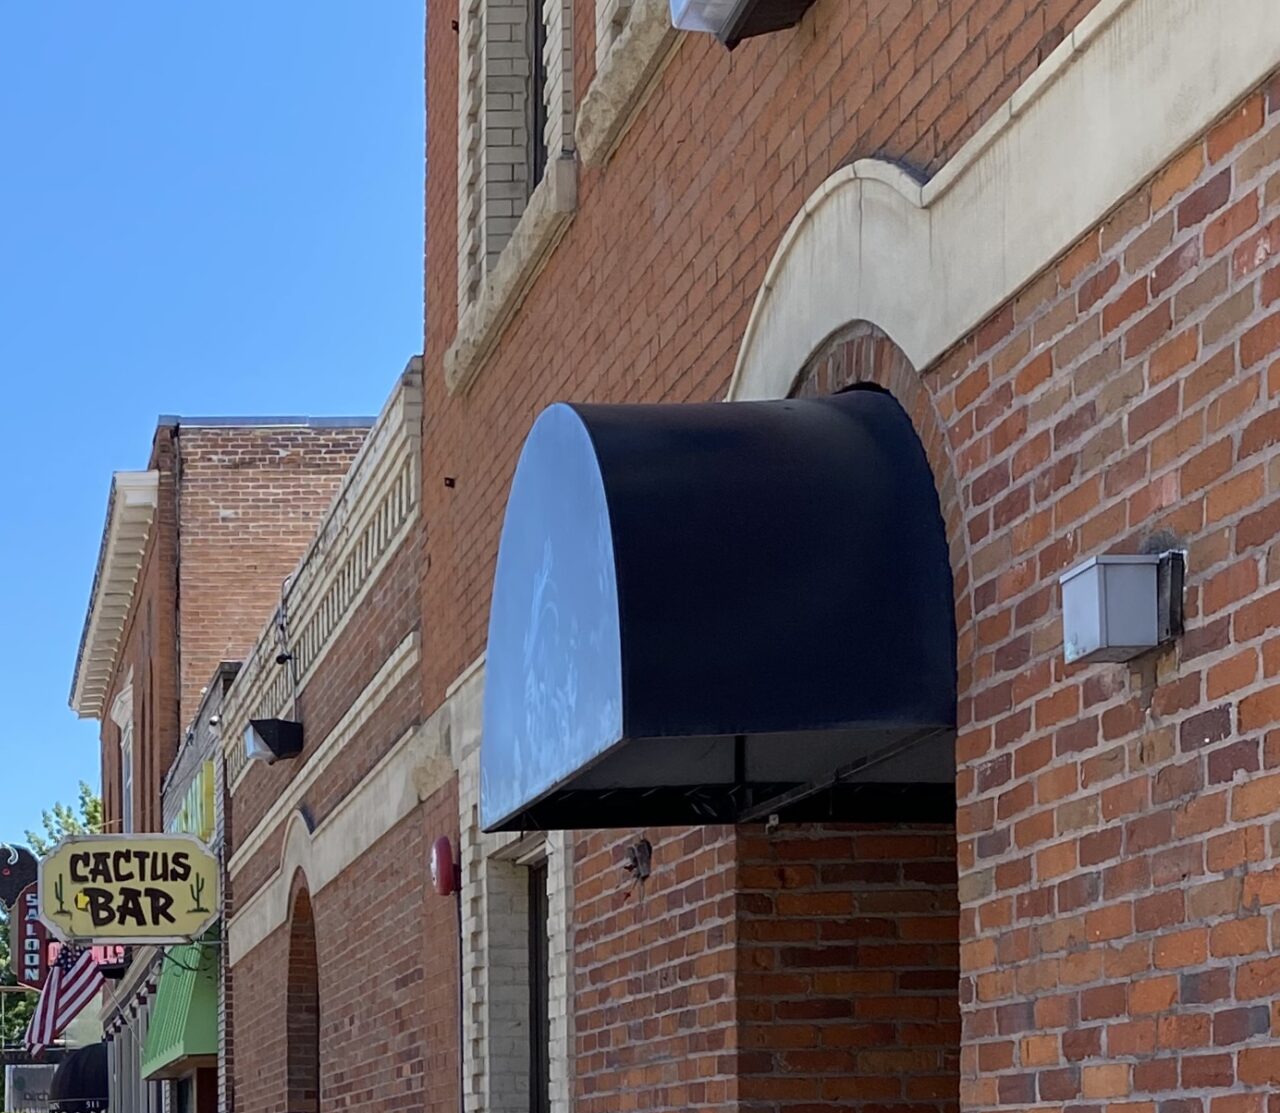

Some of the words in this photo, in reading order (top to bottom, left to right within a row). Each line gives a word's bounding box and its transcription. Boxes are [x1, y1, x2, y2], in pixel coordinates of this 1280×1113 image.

[70, 849, 191, 883] CACTUS
[83, 887, 176, 927] BAR
[24, 893, 40, 981] SALOON
